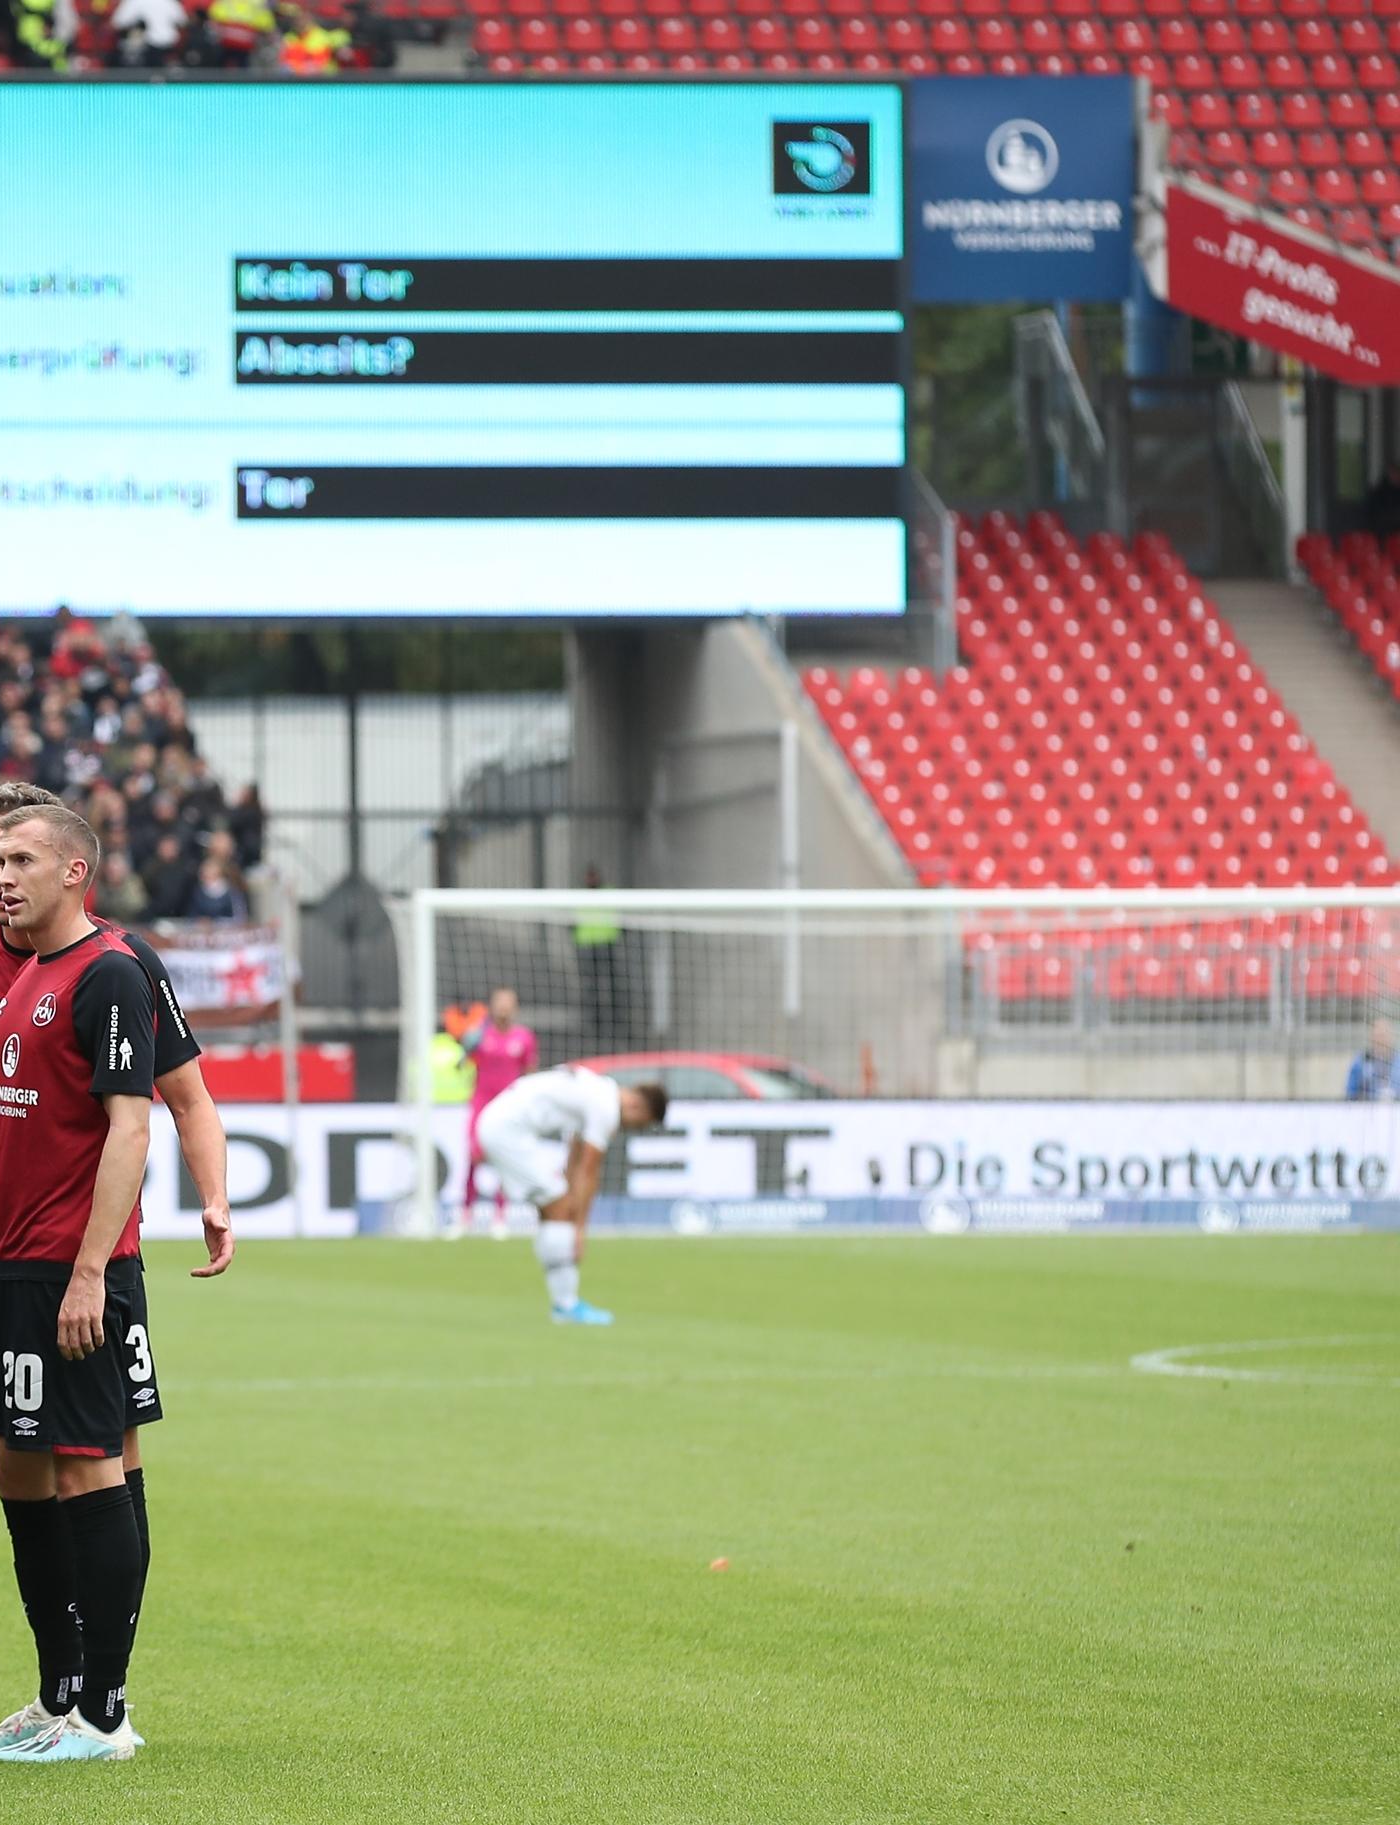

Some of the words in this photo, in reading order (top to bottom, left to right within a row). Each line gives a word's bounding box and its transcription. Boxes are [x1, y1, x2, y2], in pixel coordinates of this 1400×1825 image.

[922, 199, 1122, 232] NÜRNBERGER
[237, 262, 332, 301] Kein
[338, 262, 414, 301] Tor
[237, 335, 415, 376] Abseits?
[238, 469, 314, 509] Tor
[159, 979, 188, 1040] GODELMANN
[108, 1004, 120, 1071] GODELMANN
[908, 1139, 1003, 1190] Die
[1032, 1142, 1388, 1199] Sportwette
